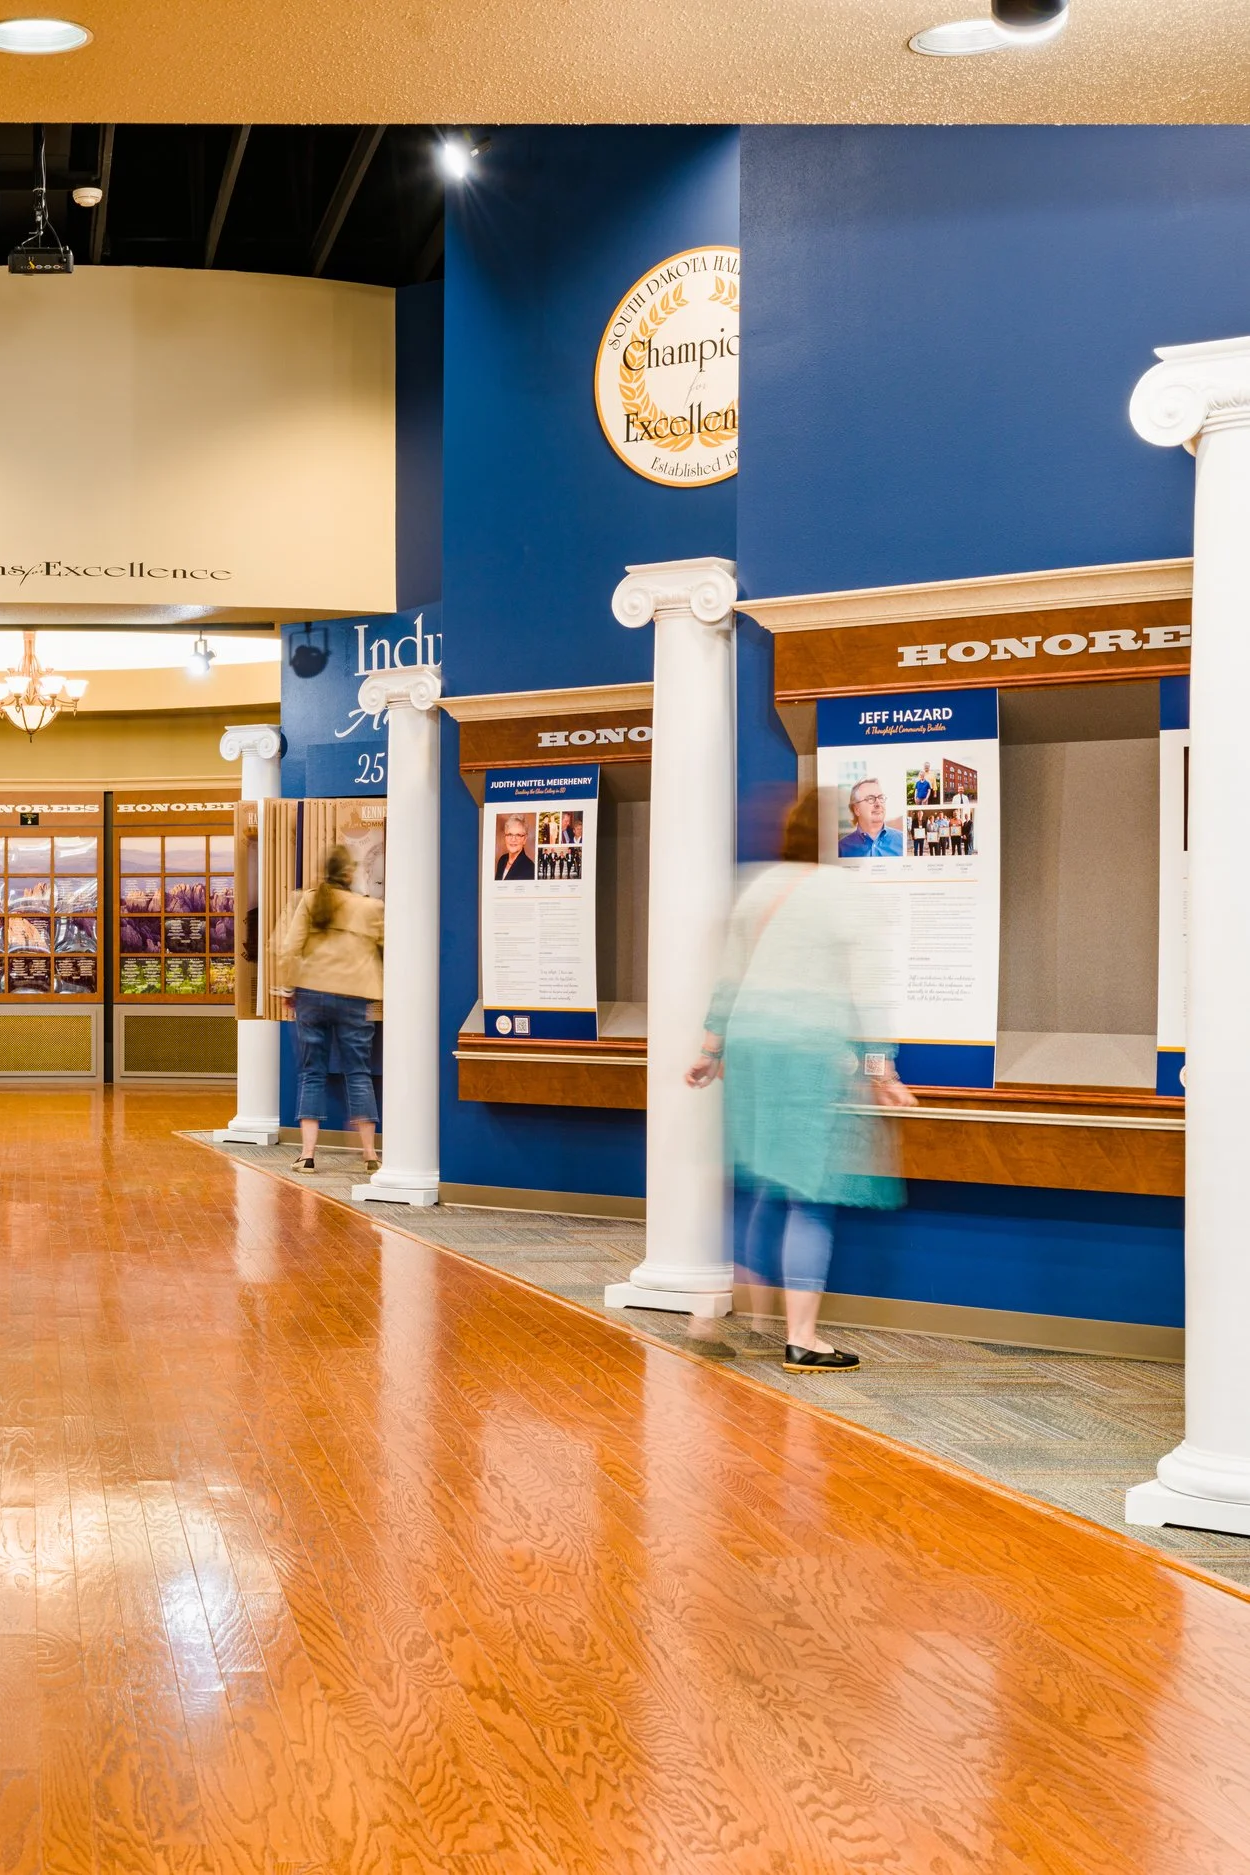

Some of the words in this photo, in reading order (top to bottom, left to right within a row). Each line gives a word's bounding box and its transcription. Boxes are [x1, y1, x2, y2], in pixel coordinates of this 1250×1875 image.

[607, 292, 647, 351] SOUTH
[645, 256, 708, 296] DAKOTA
[623, 400, 738, 443] Excellen
[650, 456, 721, 478] Established
[42, 560, 232, 582] Excellence
[858, 710, 890, 725] JEFF
[892, 707, 953, 723] HAZARD
[865, 726, 871, 735] A
[871, 725, 899, 736] Thoughtful
[898, 724, 927, 734] Community
[926, 723, 947, 732] Builder
[354, 752, 386, 784] 25
[490, 780, 516, 789] JUDITH
[516, 778, 546, 788] KNITTEL
[546, 777, 593, 787] MEIERHENRY
